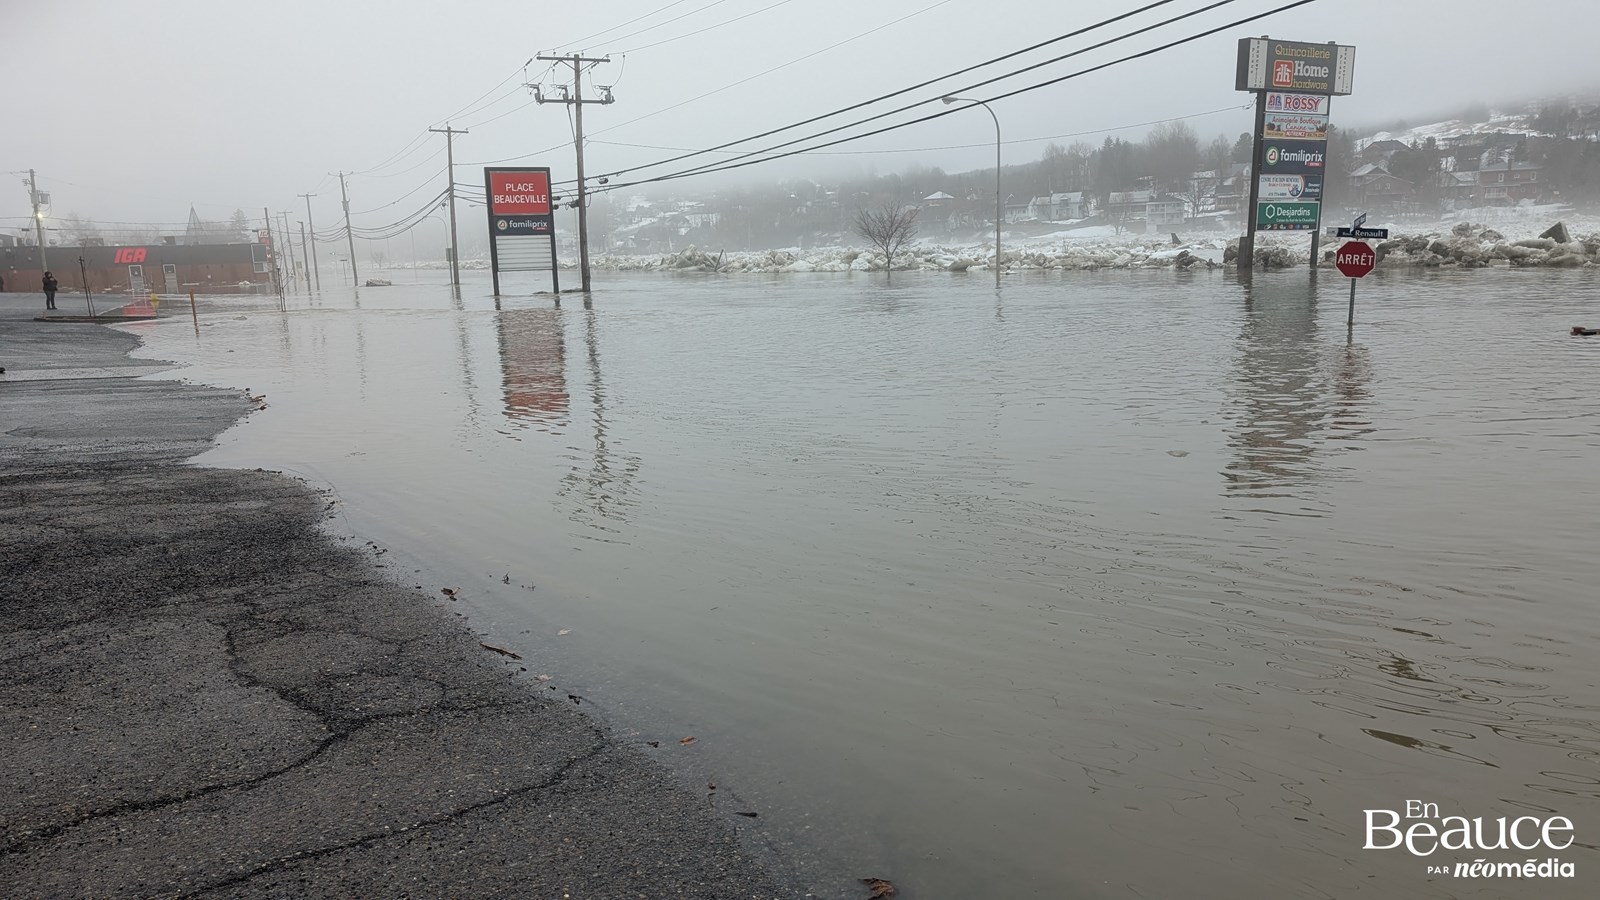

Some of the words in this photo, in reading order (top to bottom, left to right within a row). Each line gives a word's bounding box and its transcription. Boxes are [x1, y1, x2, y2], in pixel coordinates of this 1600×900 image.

[1275, 44, 1331, 59] Quincaillerie
[1293, 60, 1329, 78] Home
[1292, 78, 1328, 90] hardware
[1283, 95, 1326, 112] ROSSY
[1281, 148, 1323, 165] familiprix
[505, 183, 535, 192] PLACE
[494, 195, 547, 204] BEAUCEVILLE
[1277, 207, 1311, 218] Desjardins
[509, 220, 548, 230] familiprix
[1355, 229, 1384, 237] Renault
[114, 248, 147, 263] IGA
[1337, 253, 1374, 266] ARRÊT
